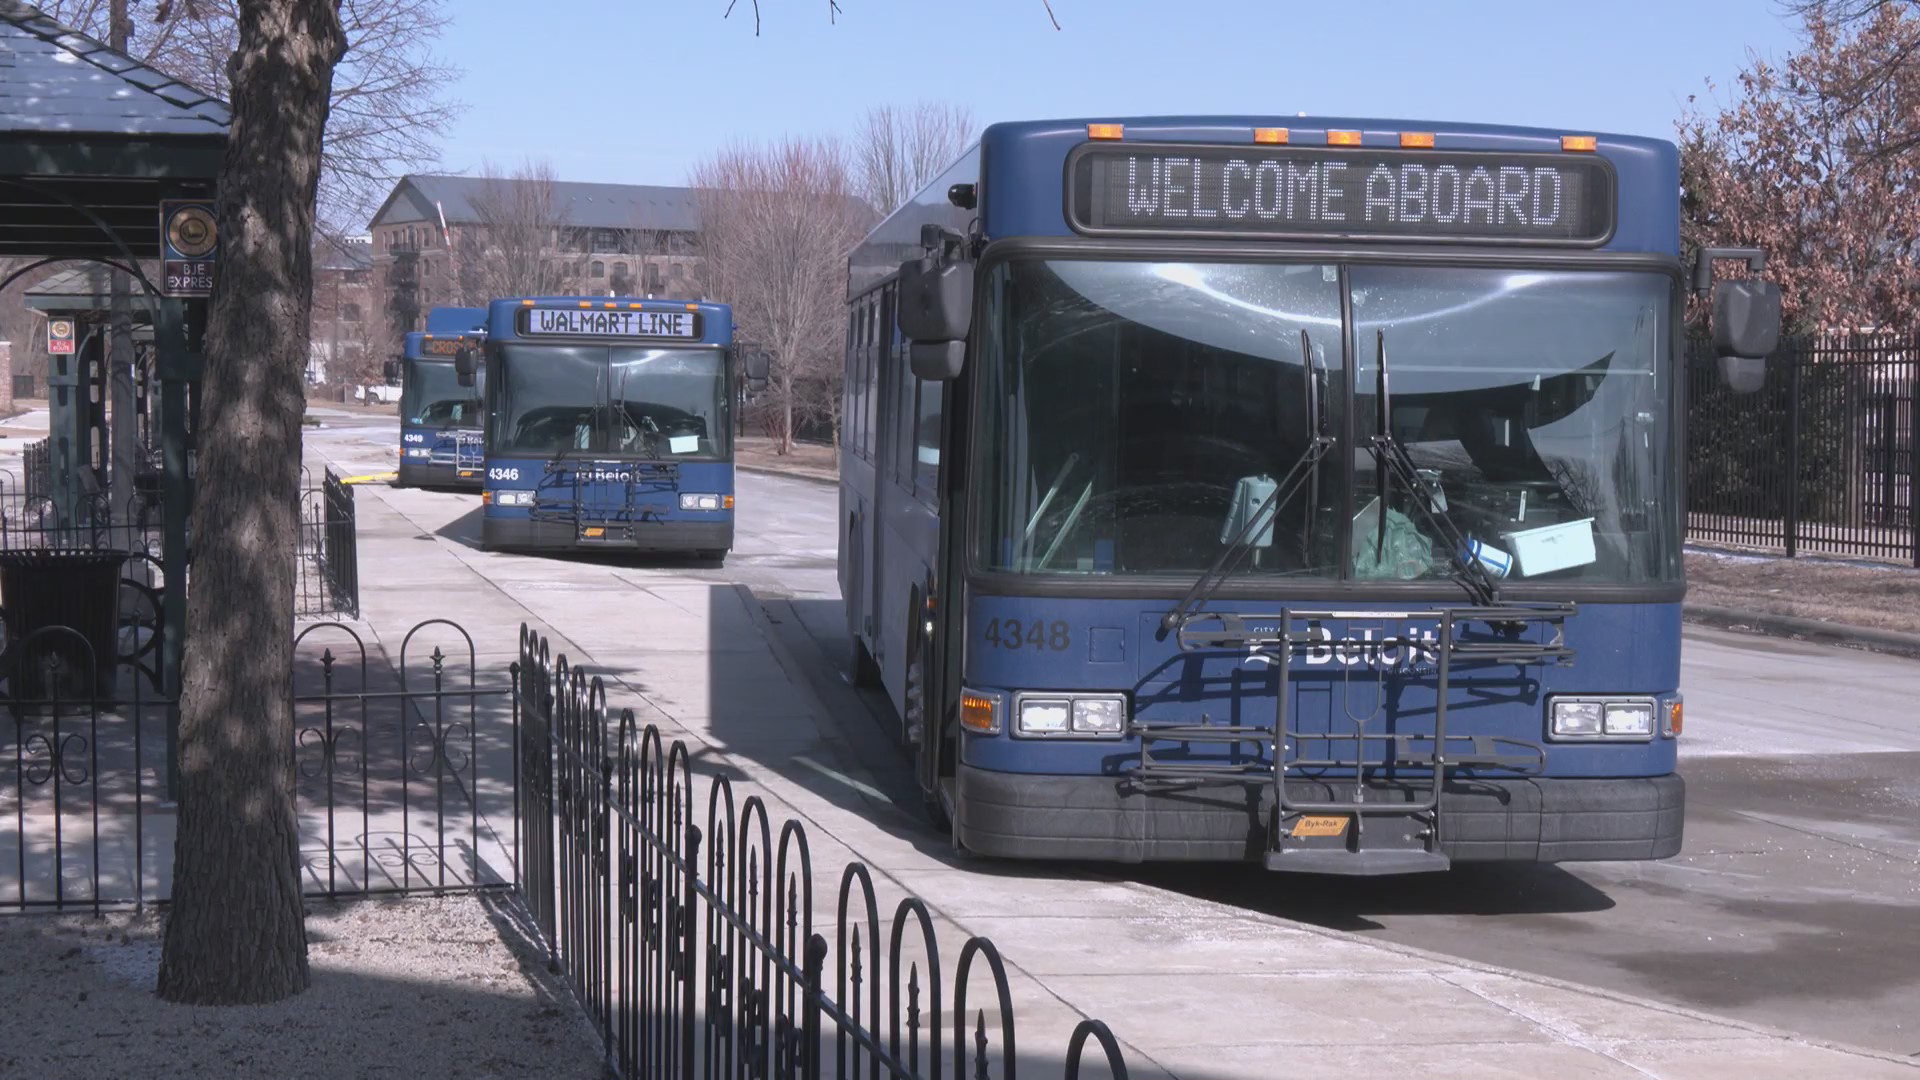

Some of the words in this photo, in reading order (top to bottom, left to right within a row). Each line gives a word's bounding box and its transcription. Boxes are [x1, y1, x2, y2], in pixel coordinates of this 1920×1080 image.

[1127, 156, 1346, 221] WELCOME
[1365, 163, 1562, 226] ABOARD
[167, 276, 213, 288] EXPRES
[540, 310, 633, 334] WALMART
[638, 313, 683, 335] LINE
[489, 468, 519, 480] 4346
[984, 617, 1071, 652] 4348
[1306, 627, 1437, 665] Beloit
